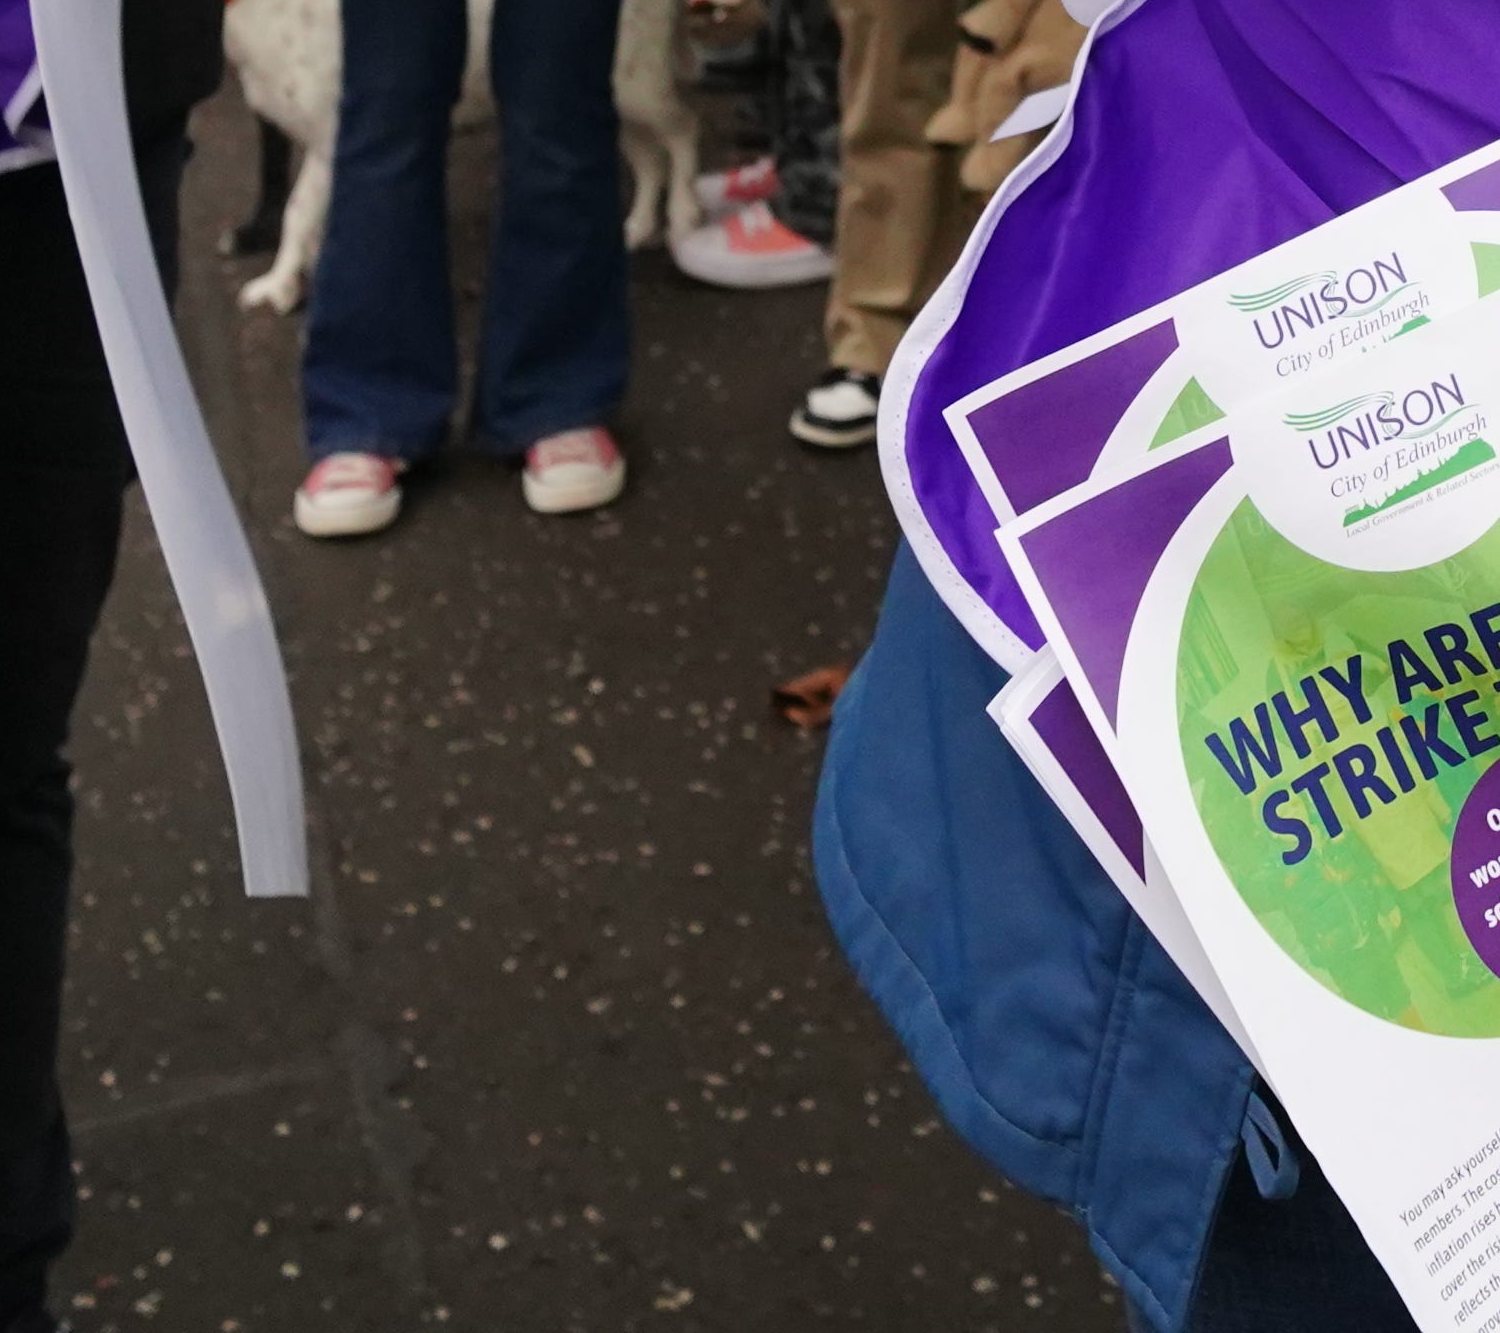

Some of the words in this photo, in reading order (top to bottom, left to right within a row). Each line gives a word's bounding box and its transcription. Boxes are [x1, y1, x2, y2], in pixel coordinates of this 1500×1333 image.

[1253, 251, 1409, 349] UNISON
[1275, 348, 1313, 378] City
[1317, 334, 1339, 359] of
[1340, 291, 1431, 348] Edinburgh
[1307, 373, 1466, 470] UNISON
[1329, 469, 1368, 499] City
[1372, 454, 1394, 481] of
[1395, 412, 1488, 471] Edinburgh
[1207, 657, 1371, 793] WHY
[1264, 692, 1498, 864] STRIKE
[1399, 1203, 1423, 1227] You
[1422, 1183, 1446, 1210] may
[1444, 1166, 1465, 1190] ask
[1414, 1204, 1465, 1252] members.
[1461, 1185, 1486, 1208] The
[1427, 1231, 1472, 1277] inflation
[1470, 1209, 1497, 1238] rises
[1440, 1269, 1468, 1301] cover
[1466, 1254, 1487, 1276] the
[1454, 1285, 1491, 1327] reflects
